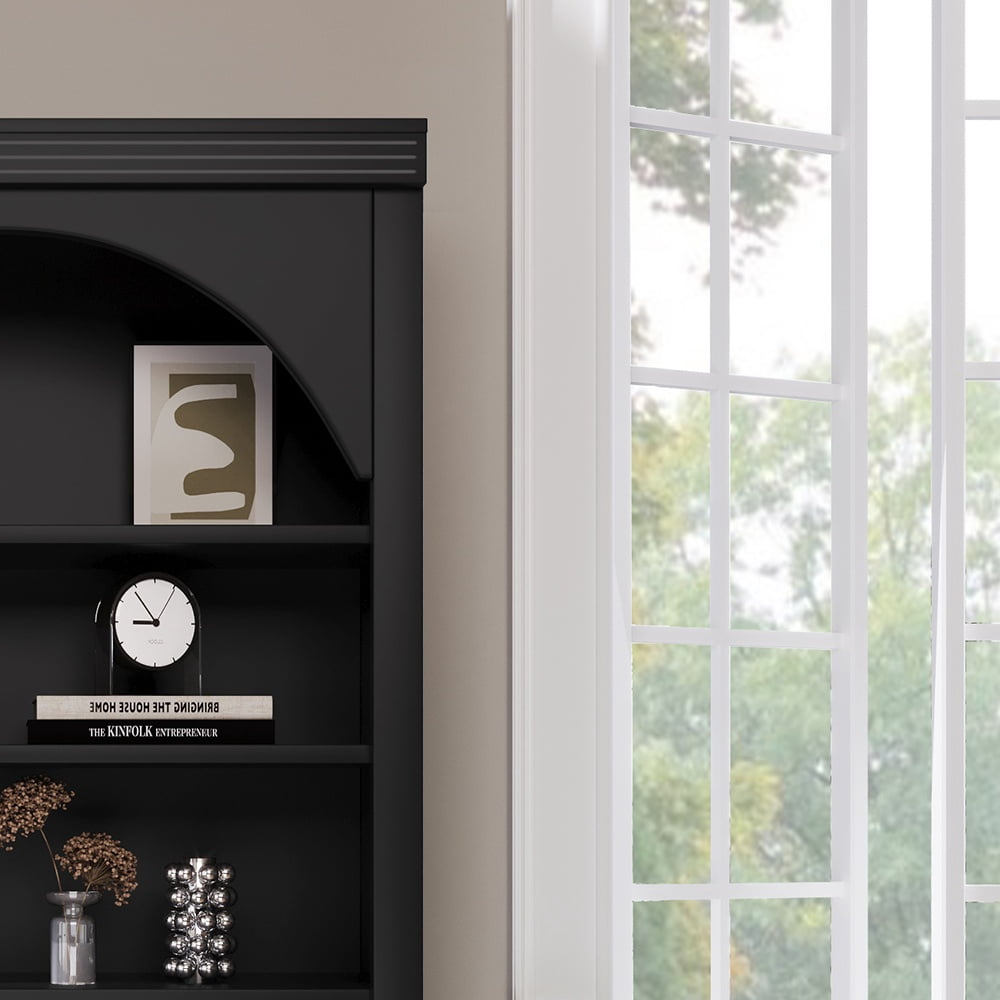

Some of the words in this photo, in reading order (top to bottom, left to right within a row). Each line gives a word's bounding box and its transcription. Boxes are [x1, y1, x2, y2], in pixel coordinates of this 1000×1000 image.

[89, 727, 106, 737] THE
[107, 725, 153, 737] KINFOLK
[155, 728, 218, 738] ENTREPRENEUR
